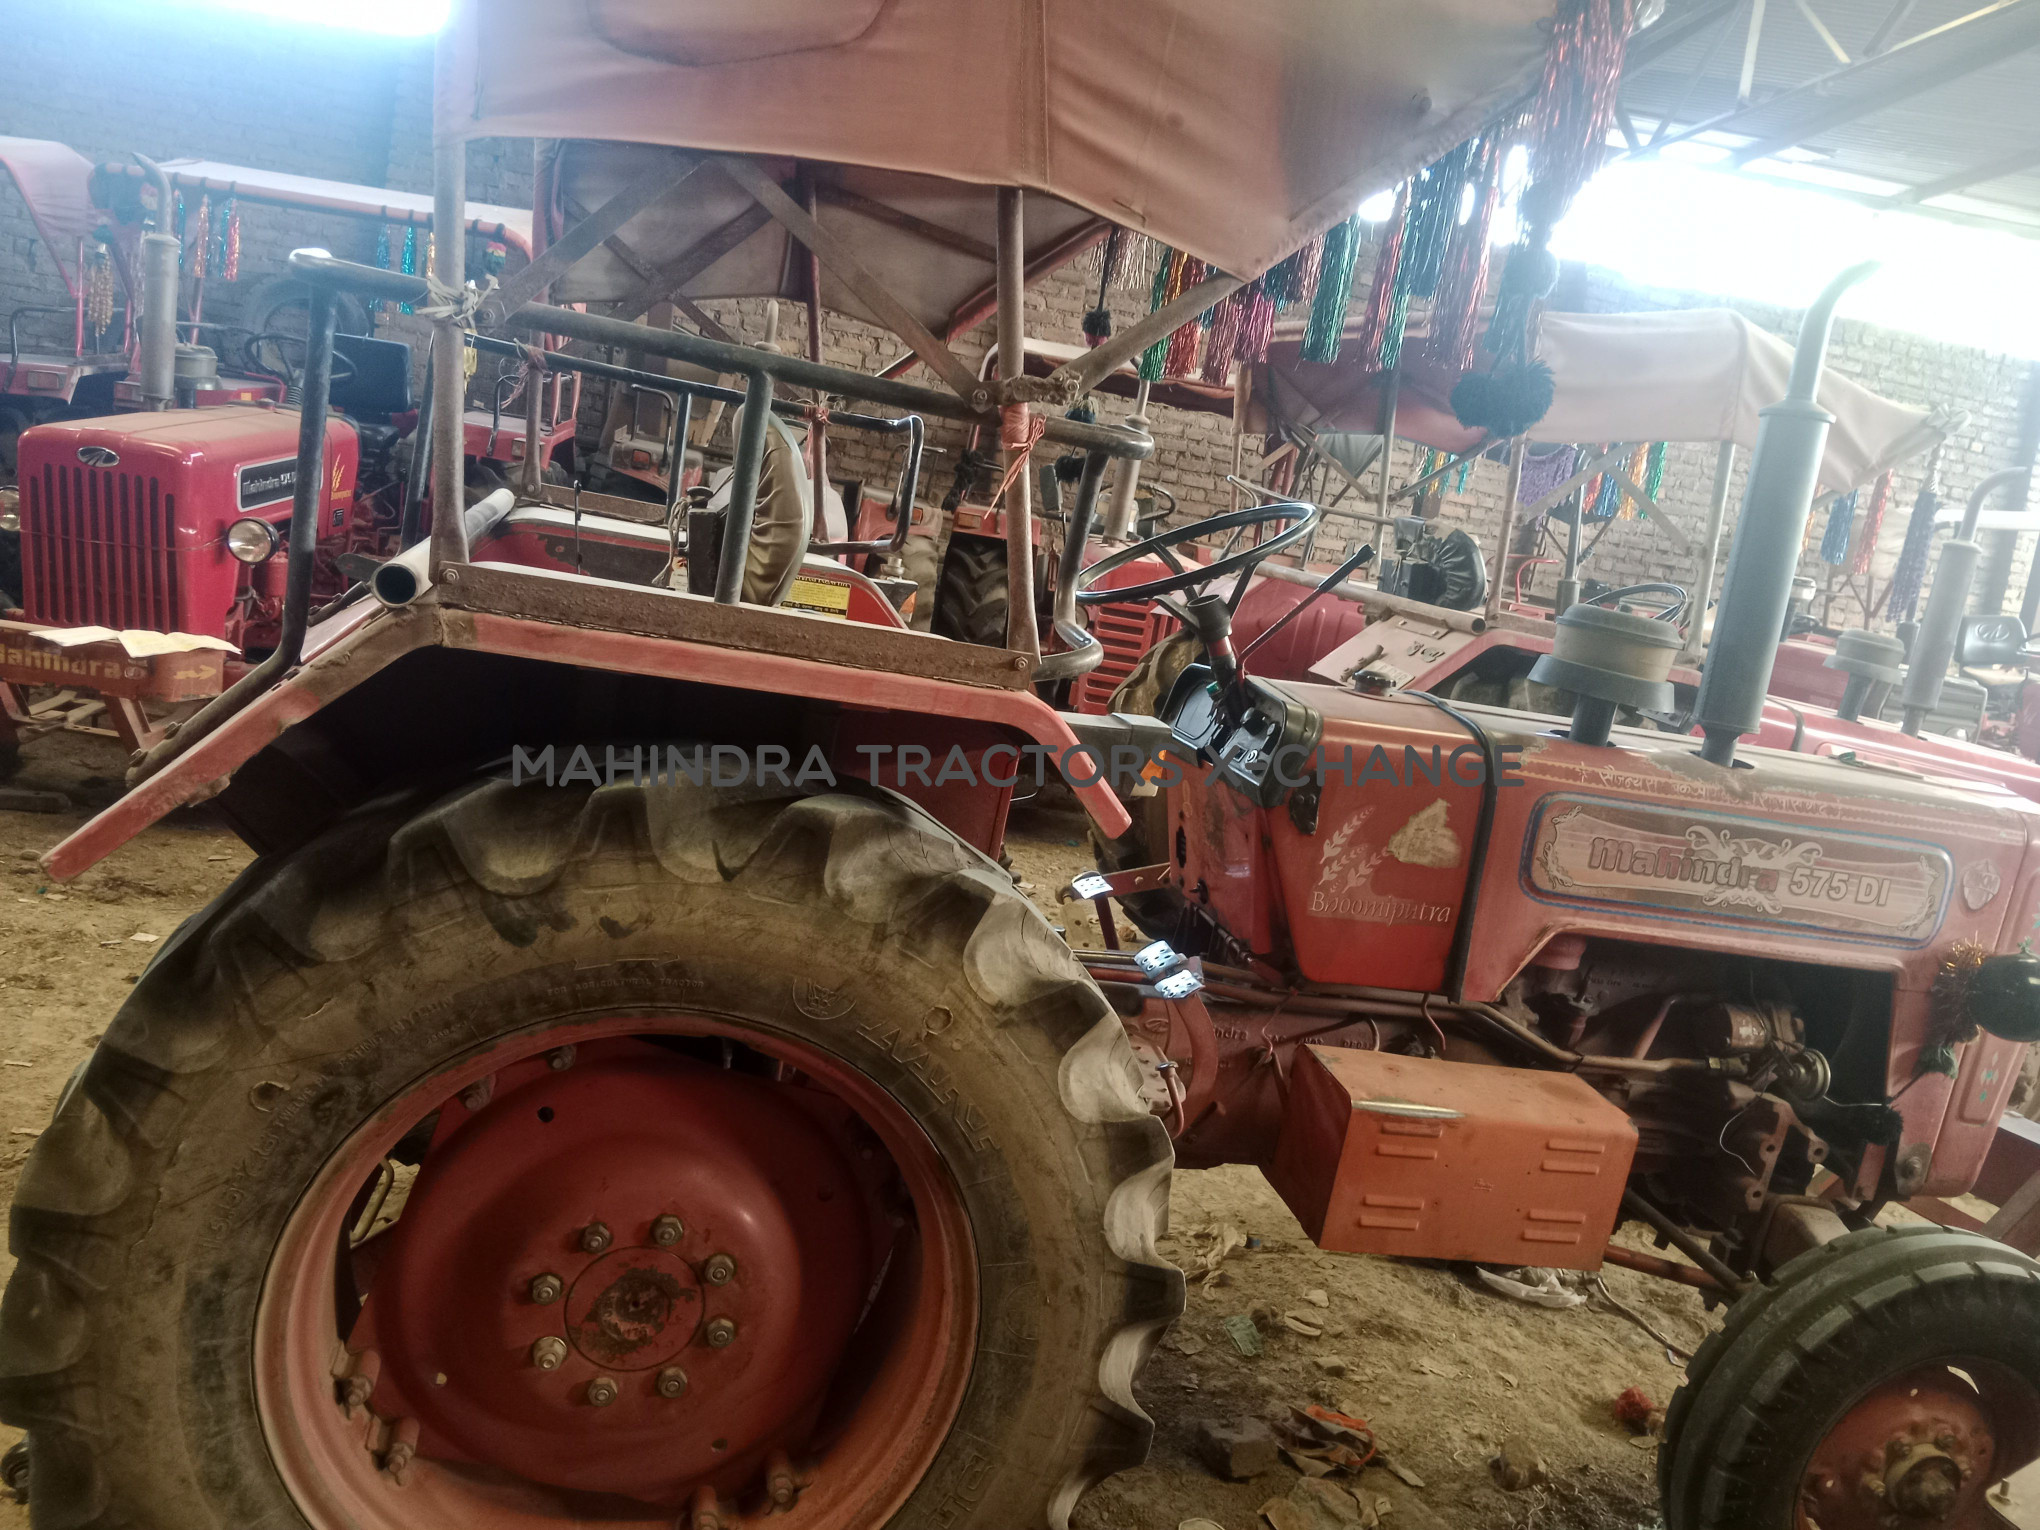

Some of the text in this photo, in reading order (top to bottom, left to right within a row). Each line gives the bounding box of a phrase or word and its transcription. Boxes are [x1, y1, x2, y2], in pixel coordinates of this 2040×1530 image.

[1588, 836, 1891, 907] Mahindra 575 DI
